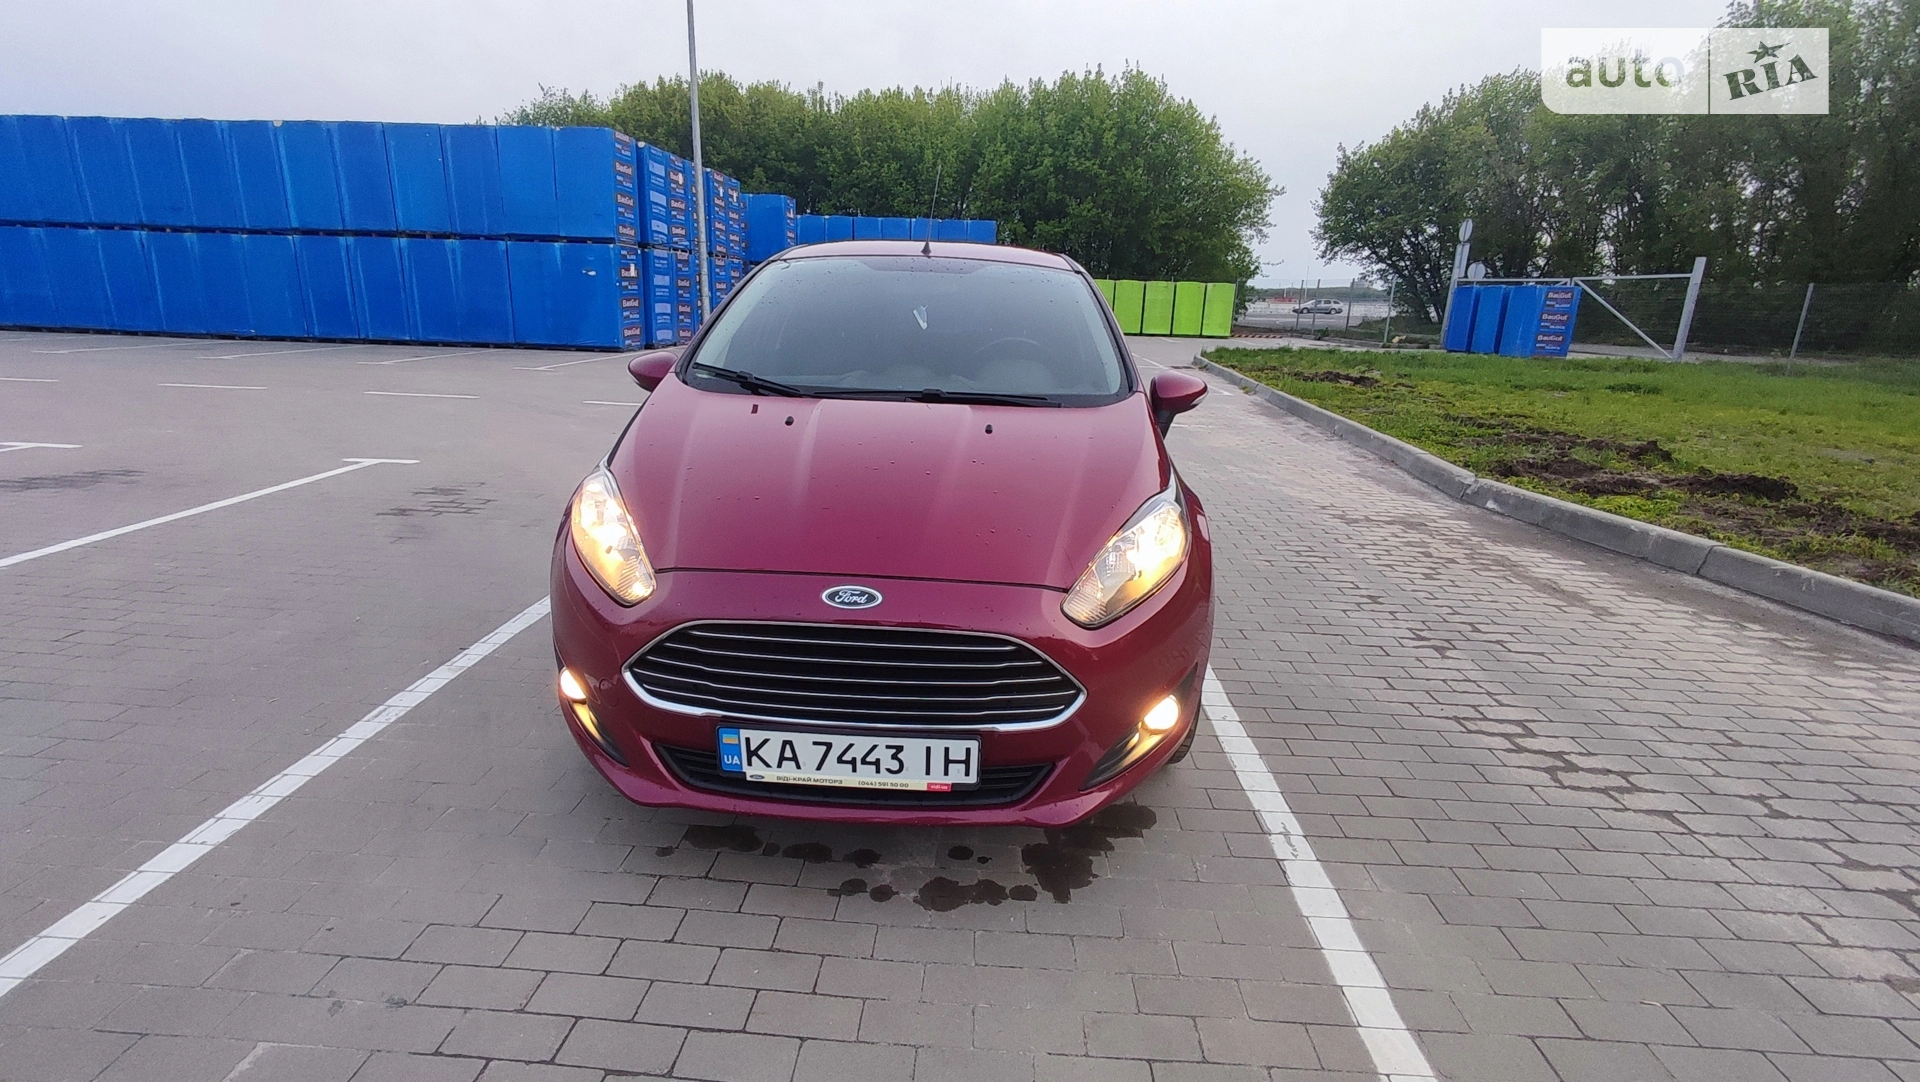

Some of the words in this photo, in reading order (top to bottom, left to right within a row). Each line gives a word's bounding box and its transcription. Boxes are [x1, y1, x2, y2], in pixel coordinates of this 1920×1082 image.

[835, 589, 869, 604] Ford
[724, 754, 741, 766] UA
[744, 736, 802, 770] KA
[812, 740, 905, 775] 7443
[925, 746, 972, 777] IH
